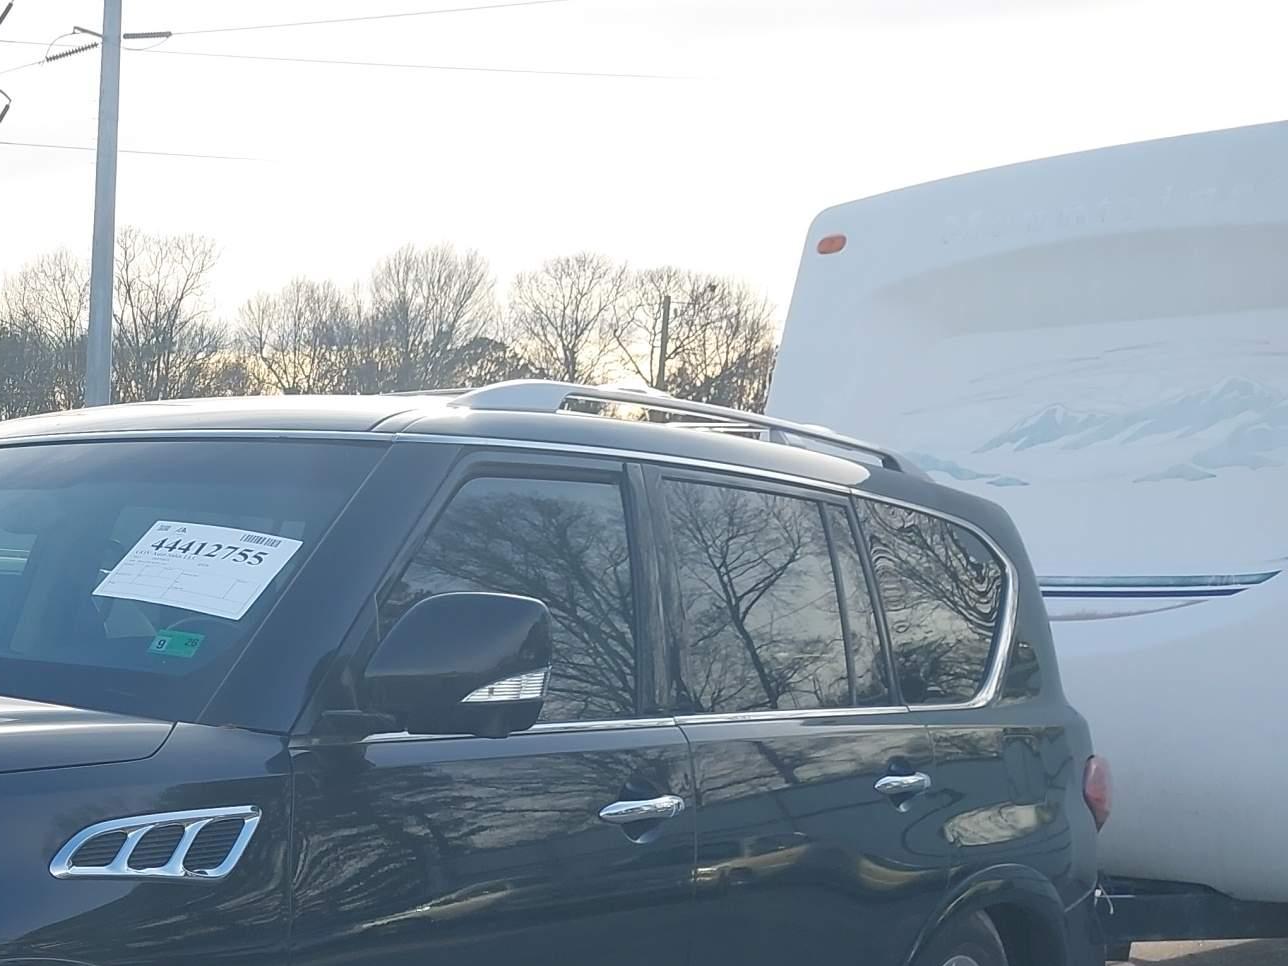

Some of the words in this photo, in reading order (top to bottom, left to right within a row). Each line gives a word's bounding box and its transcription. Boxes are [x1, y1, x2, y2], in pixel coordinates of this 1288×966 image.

[151, 538, 269, 566] 44412755
[156, 639, 166, 649] 9
[184, 638, 199, 647] 26
